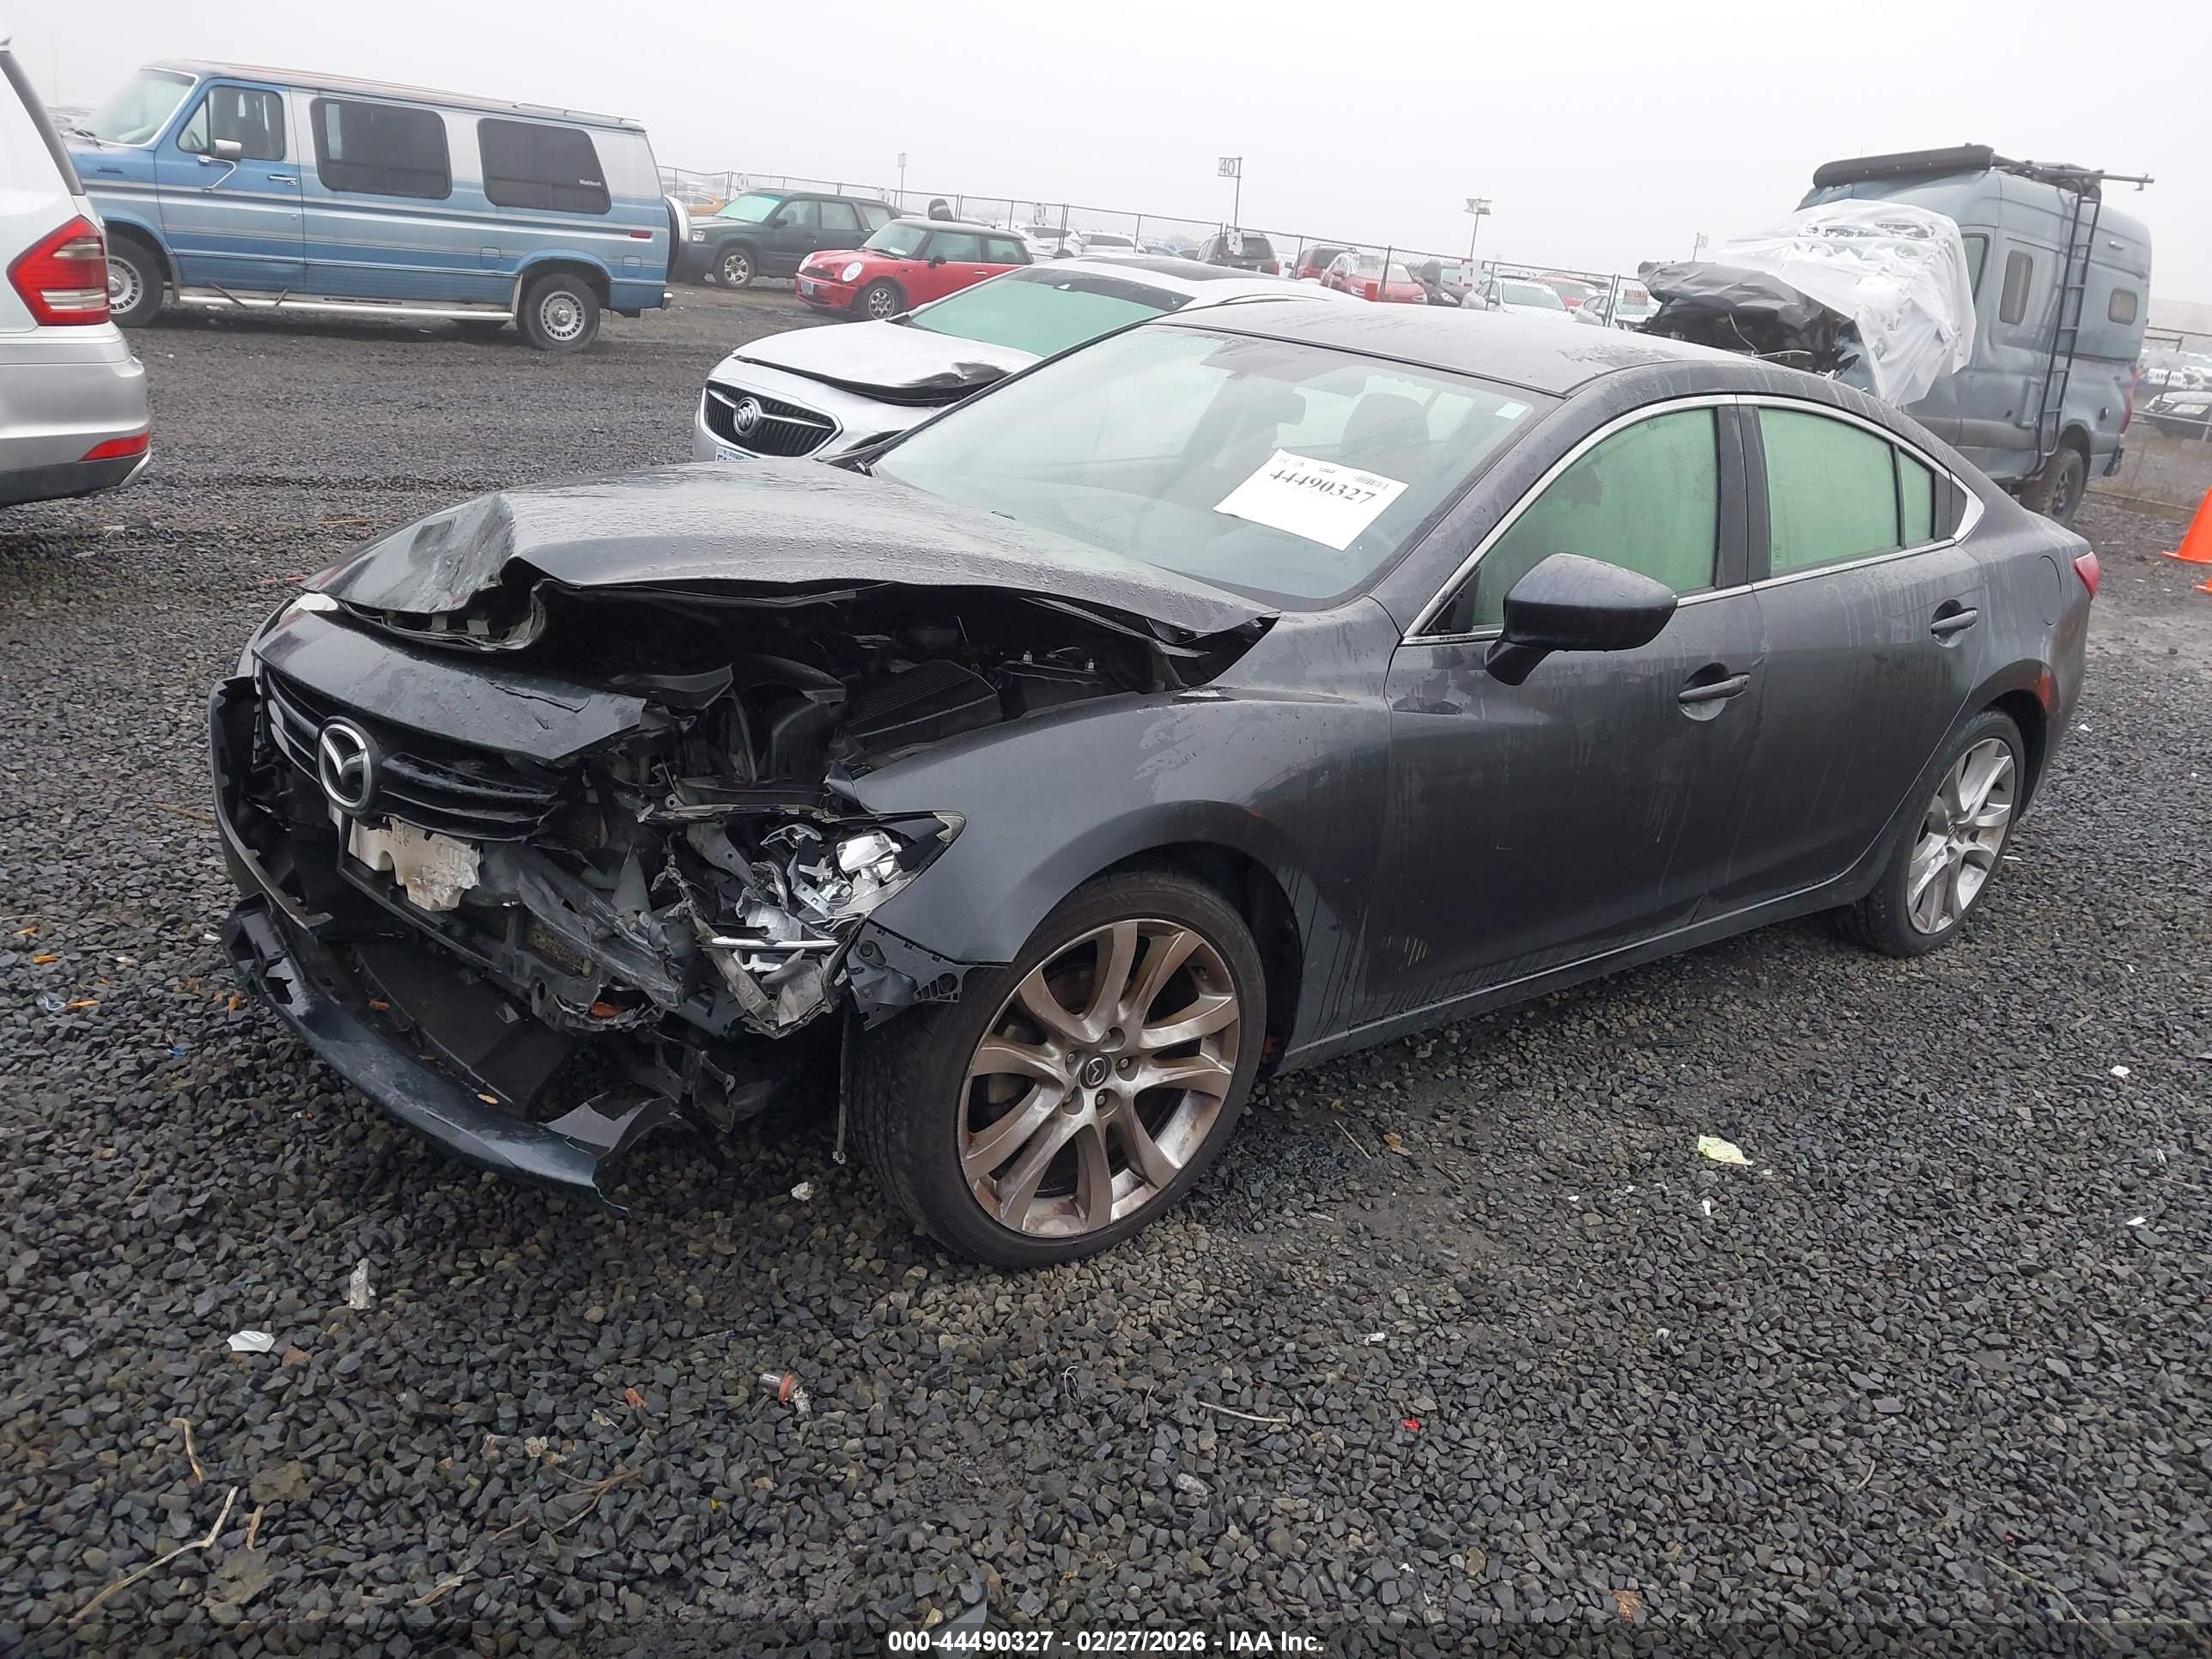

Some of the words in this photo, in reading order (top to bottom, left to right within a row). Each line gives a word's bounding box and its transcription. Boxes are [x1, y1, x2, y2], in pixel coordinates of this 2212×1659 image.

[1219, 158, 1236, 175] 40
[1231, 236, 1238, 246] 2
[1269, 469, 1377, 504] 44490327
